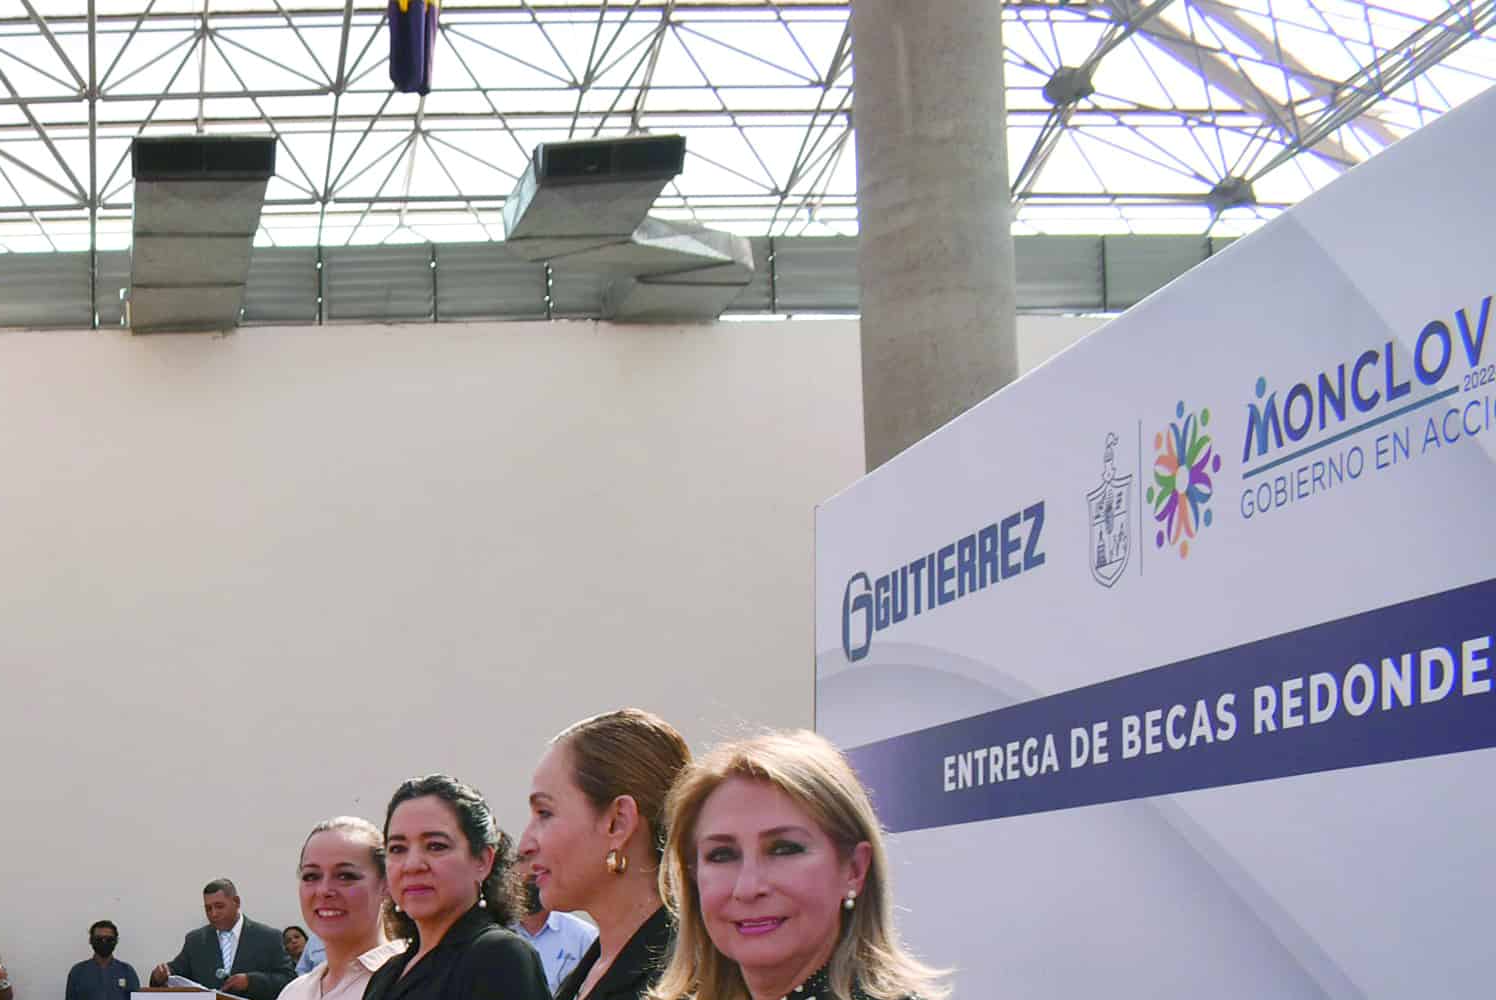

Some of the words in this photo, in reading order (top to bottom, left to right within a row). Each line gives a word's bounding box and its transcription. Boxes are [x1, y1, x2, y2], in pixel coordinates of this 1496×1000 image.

[1240, 445, 1364, 519] GOBIERNO
[1375, 426, 1410, 470] EN
[1422, 395, 1496, 454] ACCI
[943, 733, 1060, 793] ENTREGA
[1070, 721, 1109, 769] DE
[1120, 693, 1236, 760] BECAS
